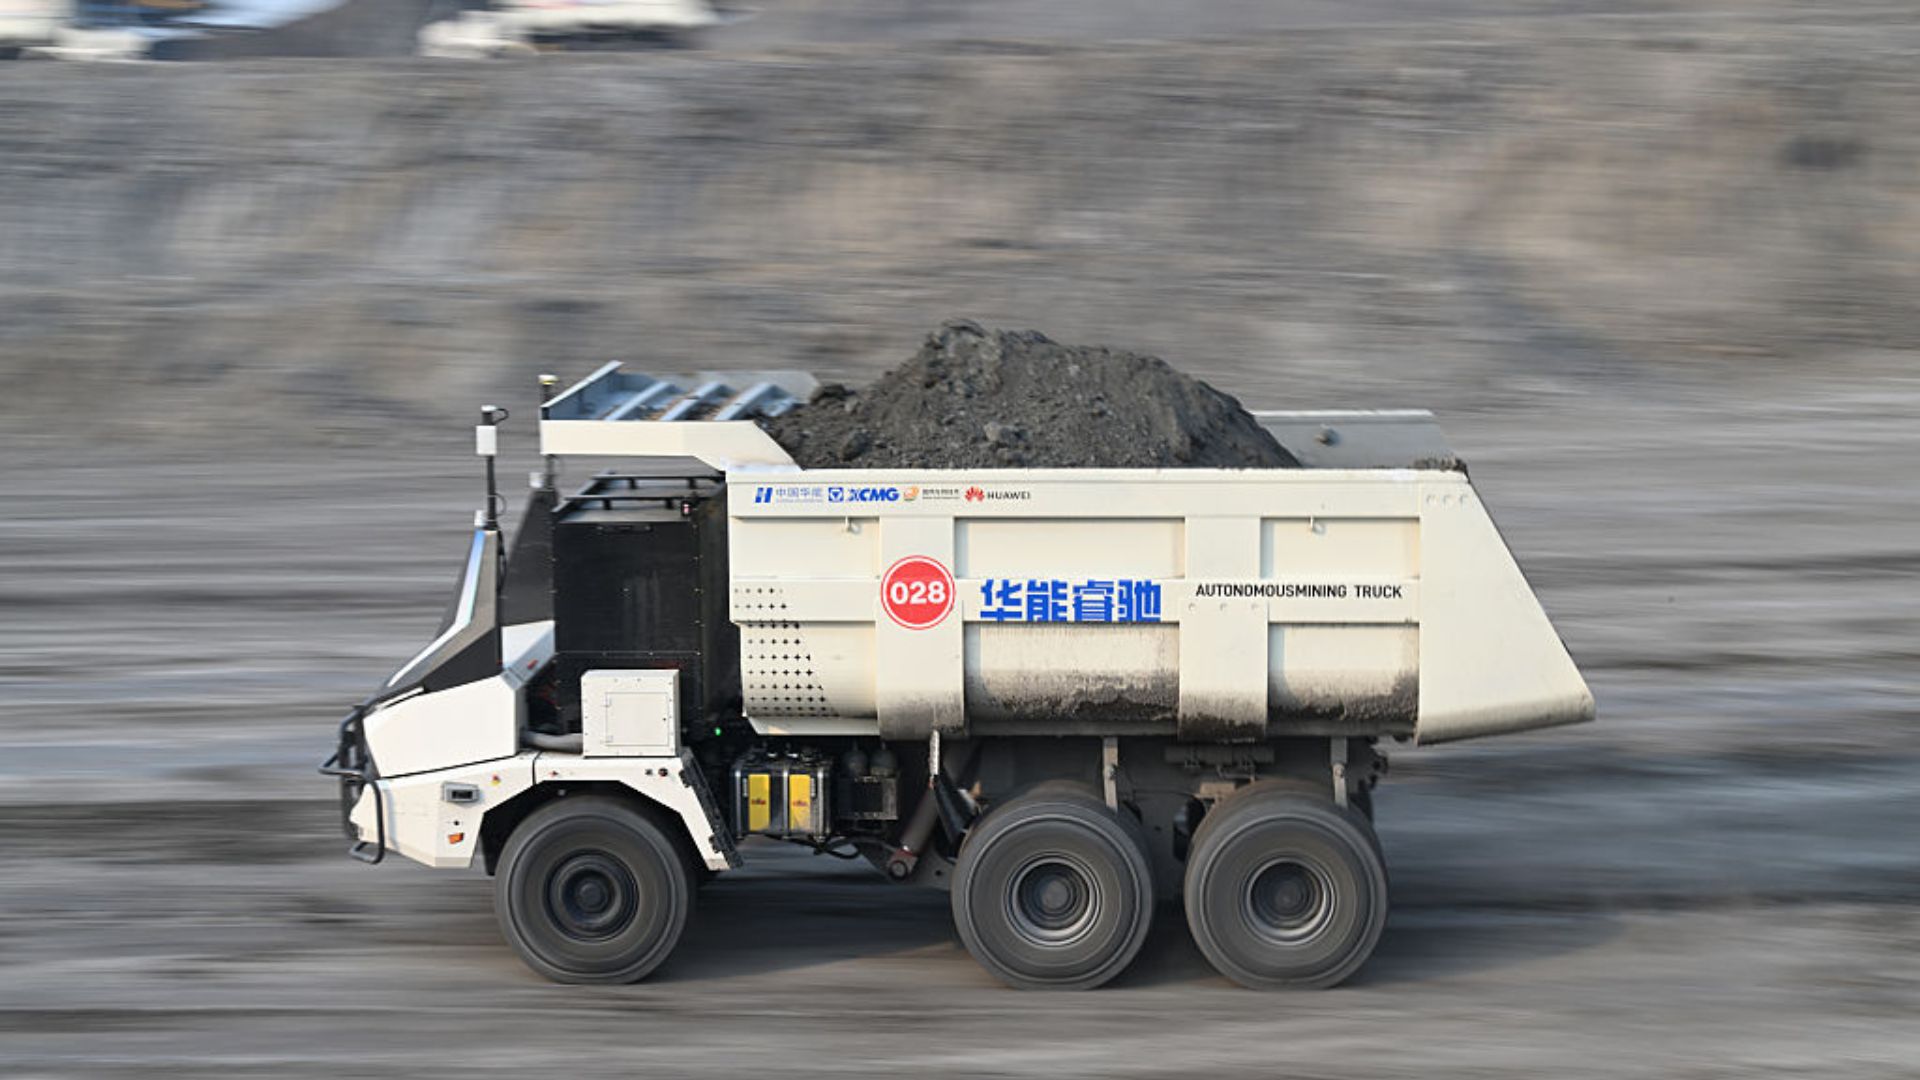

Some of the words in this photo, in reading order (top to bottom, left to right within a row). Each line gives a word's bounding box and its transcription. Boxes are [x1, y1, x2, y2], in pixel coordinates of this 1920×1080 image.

[848, 487, 900, 502] XCMG
[987, 491, 1031, 500] HUAWEI
[889, 580, 947, 606] 028
[1195, 583, 1347, 599] AUTONOMOUSMINING
[1354, 584, 1403, 599] TRUCK
[979, 578, 1162, 623] 华能睿驰
